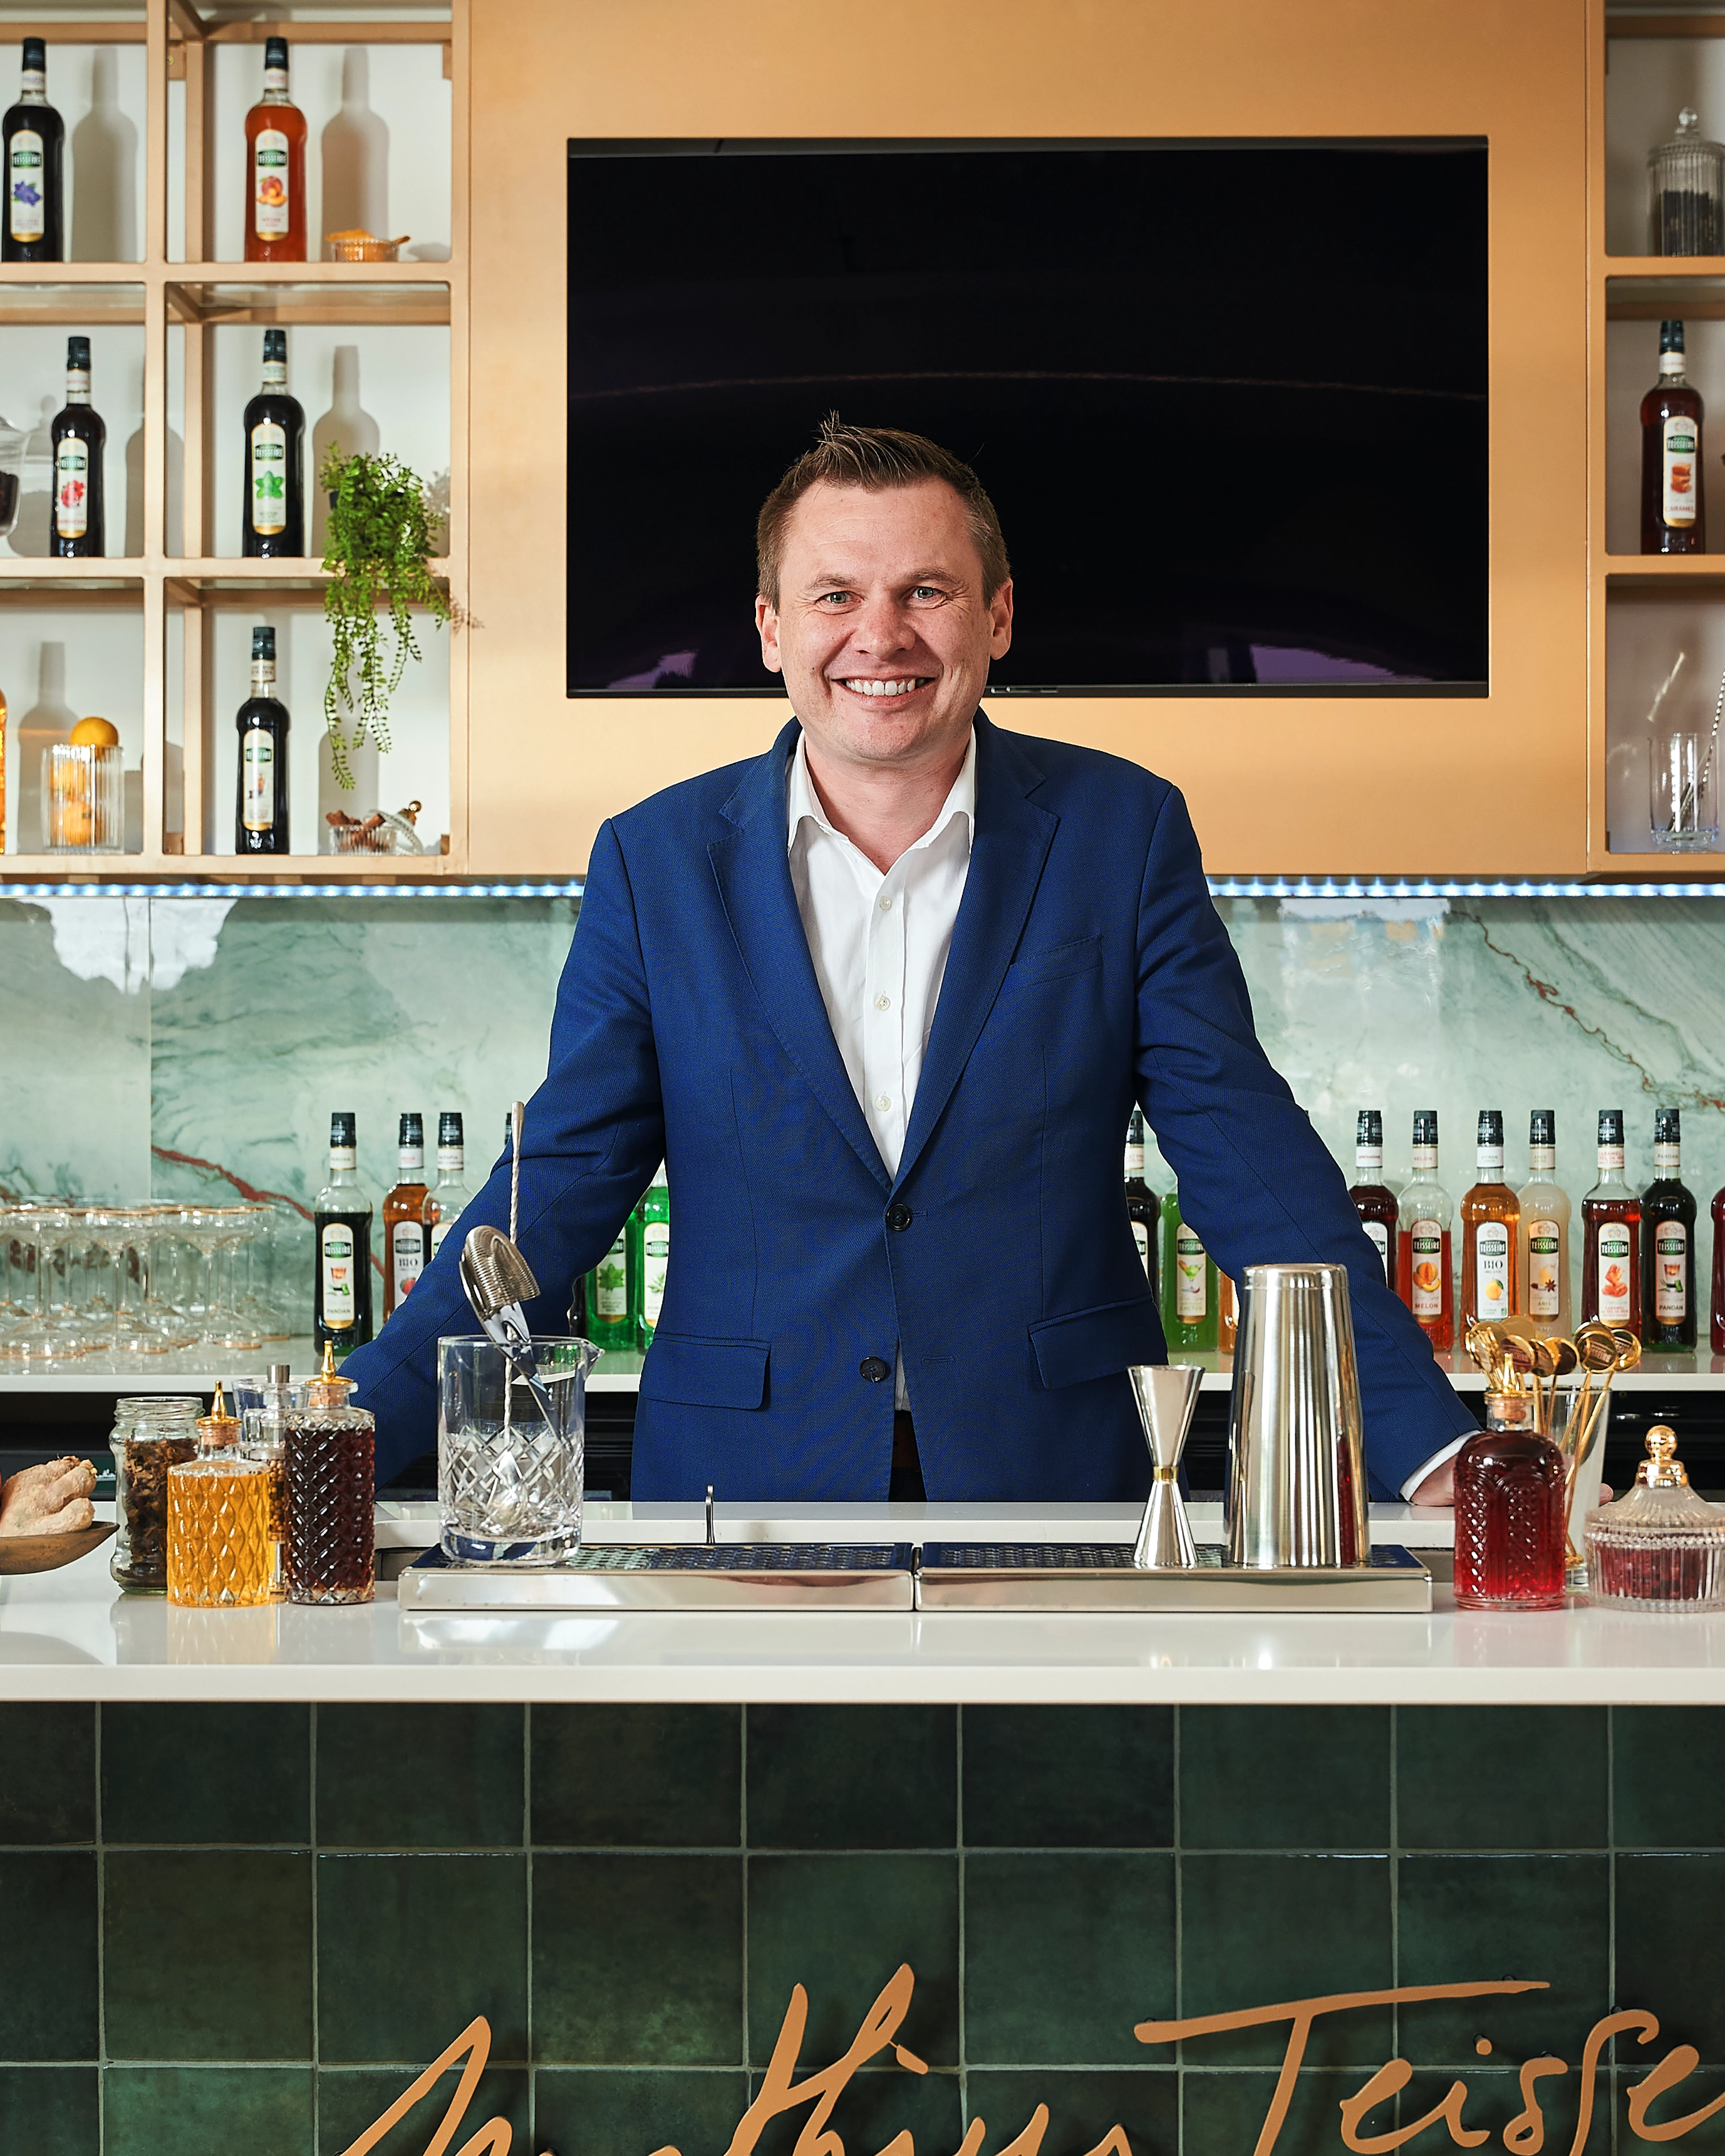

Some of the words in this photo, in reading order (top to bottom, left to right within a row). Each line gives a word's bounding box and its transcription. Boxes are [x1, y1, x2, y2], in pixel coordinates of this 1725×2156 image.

[1414, 1241, 1440, 1250] TEISSEIRE
[1479, 1243, 1505, 1253] TEISSEIRE
[1532, 1241, 1558, 1250] TEISSEIRE
[1601, 1244, 1628, 1254] TEISSEIRE
[1658, 1242, 1684, 1252] TEISSEIRE
[399, 1259, 418, 1267] BIO
[1483, 1260, 1503, 1269] BIO
